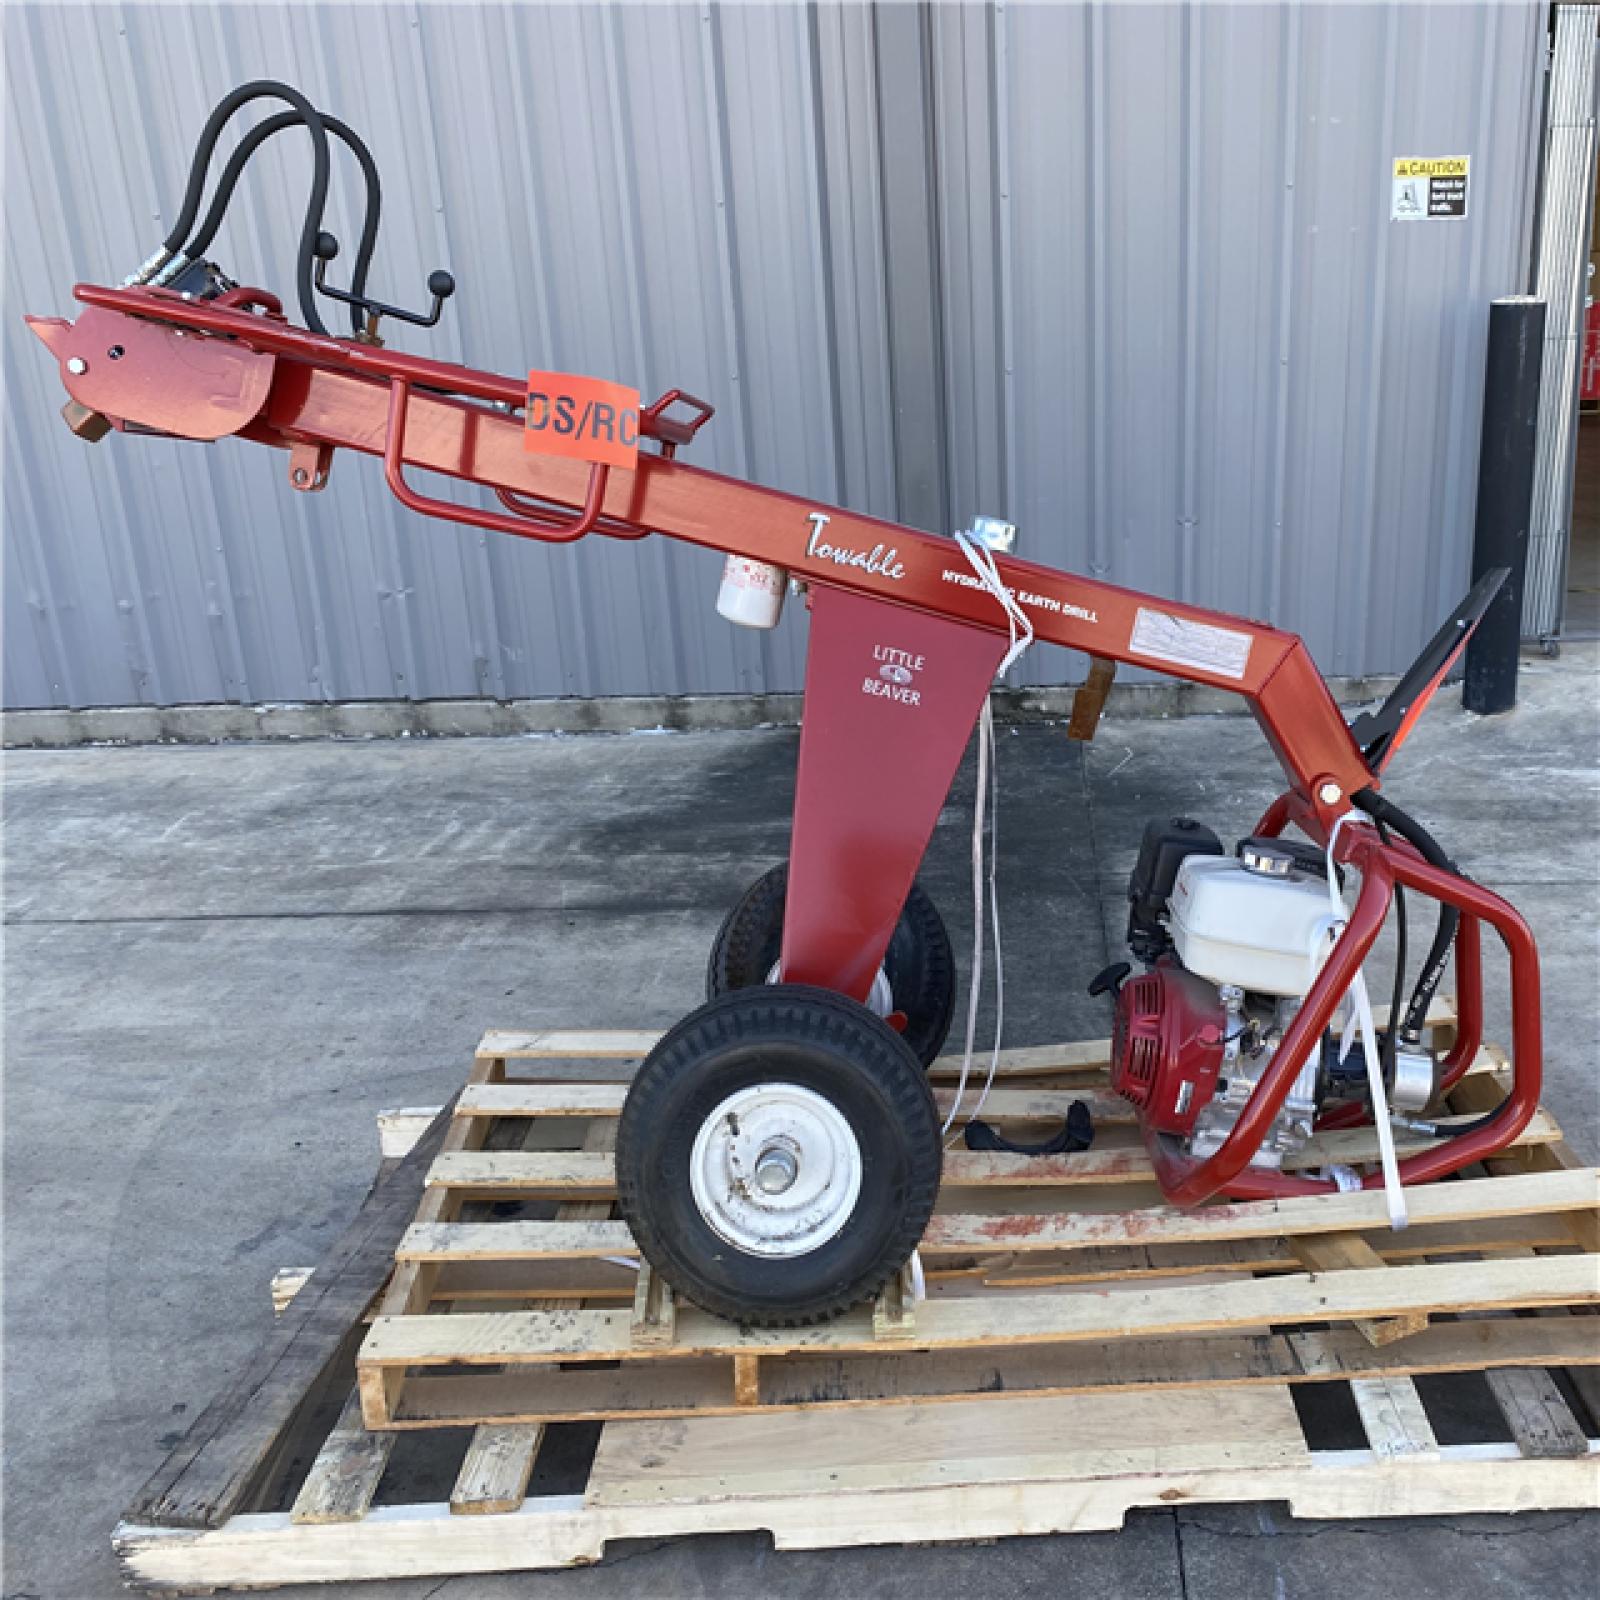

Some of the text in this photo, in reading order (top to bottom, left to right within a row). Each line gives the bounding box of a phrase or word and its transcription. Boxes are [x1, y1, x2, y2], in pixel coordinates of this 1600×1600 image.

[1409, 160, 1465, 174] CAUTION
[528, 391, 638, 446] DS/RC
[805, 511, 906, 579] Towable
[1018, 589, 1061, 612] EARTH
[1062, 602, 1099, 624] DRILL
[873, 643, 926, 671] LITTLE
[862, 676, 921, 706] BEAVER
